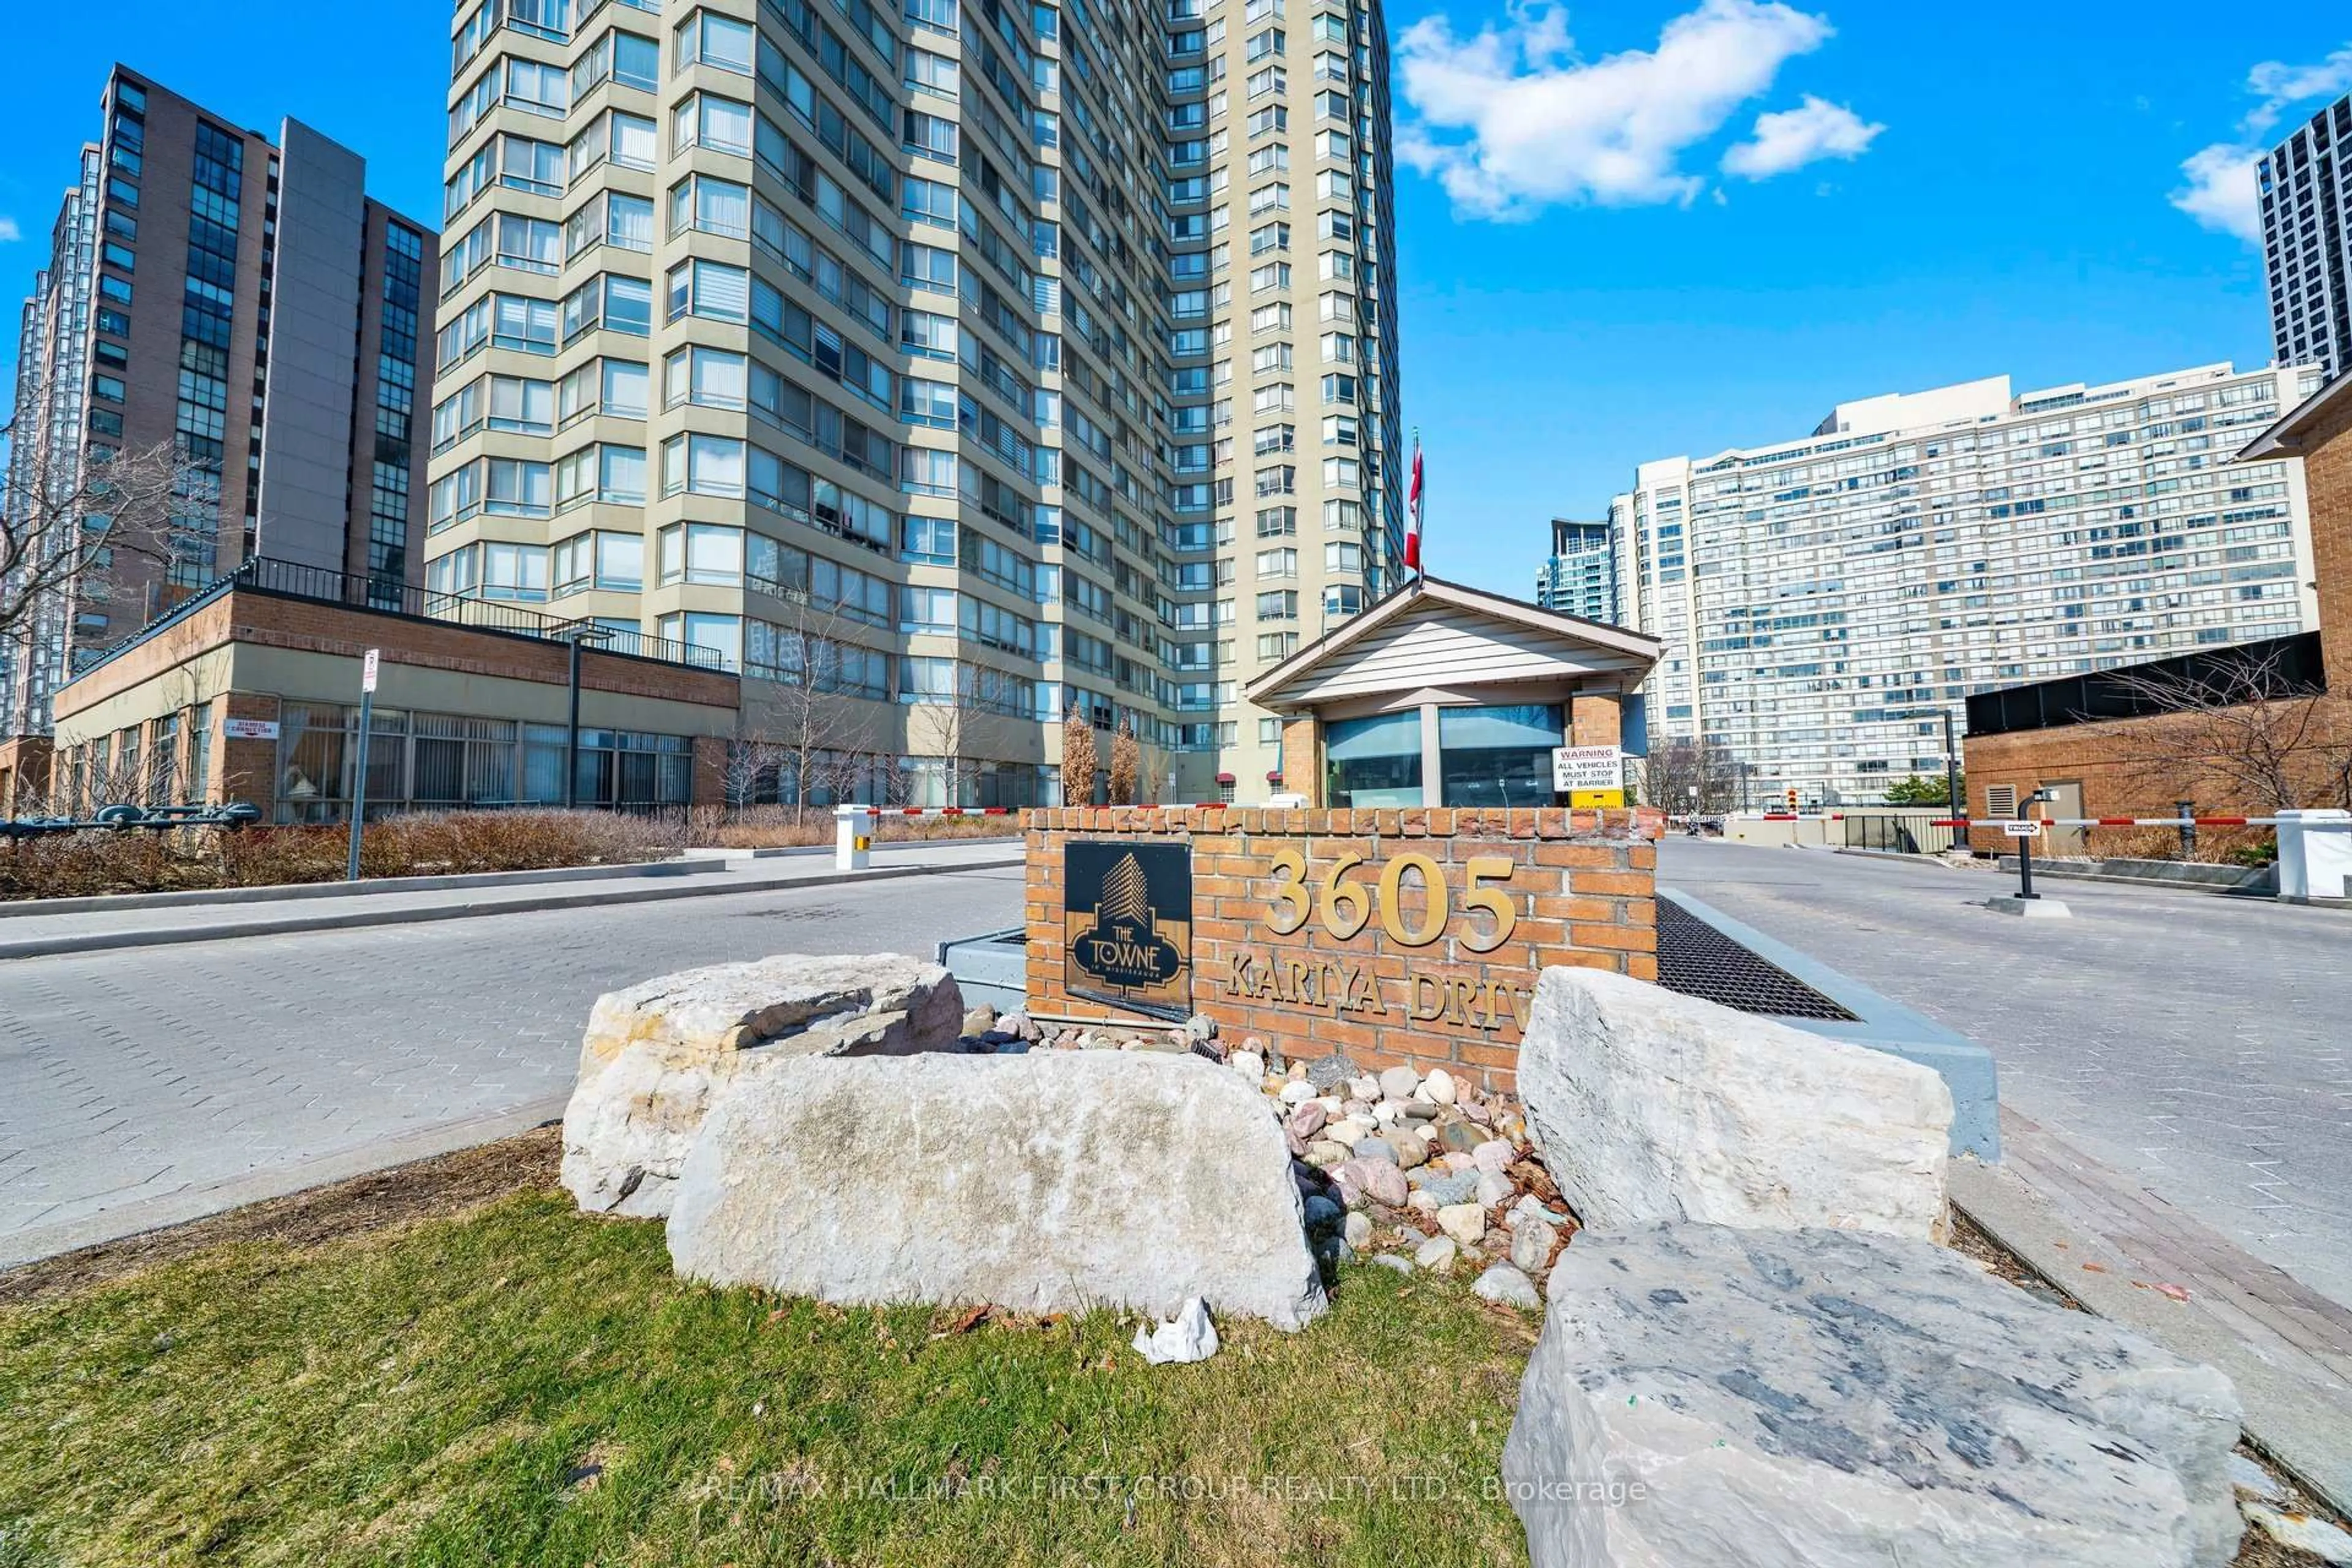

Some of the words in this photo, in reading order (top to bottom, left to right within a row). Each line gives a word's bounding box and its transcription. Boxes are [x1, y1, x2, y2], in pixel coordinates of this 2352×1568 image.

[1561, 749, 1613, 759] WARNING
[1264, 849, 1517, 954] 3605
[1112, 925, 1134, 941] THE
[1088, 940, 1161, 971] TOWNE
[1225, 951, 1387, 1016] KARIYA
[1410, 971, 1537, 1035] DRIV
